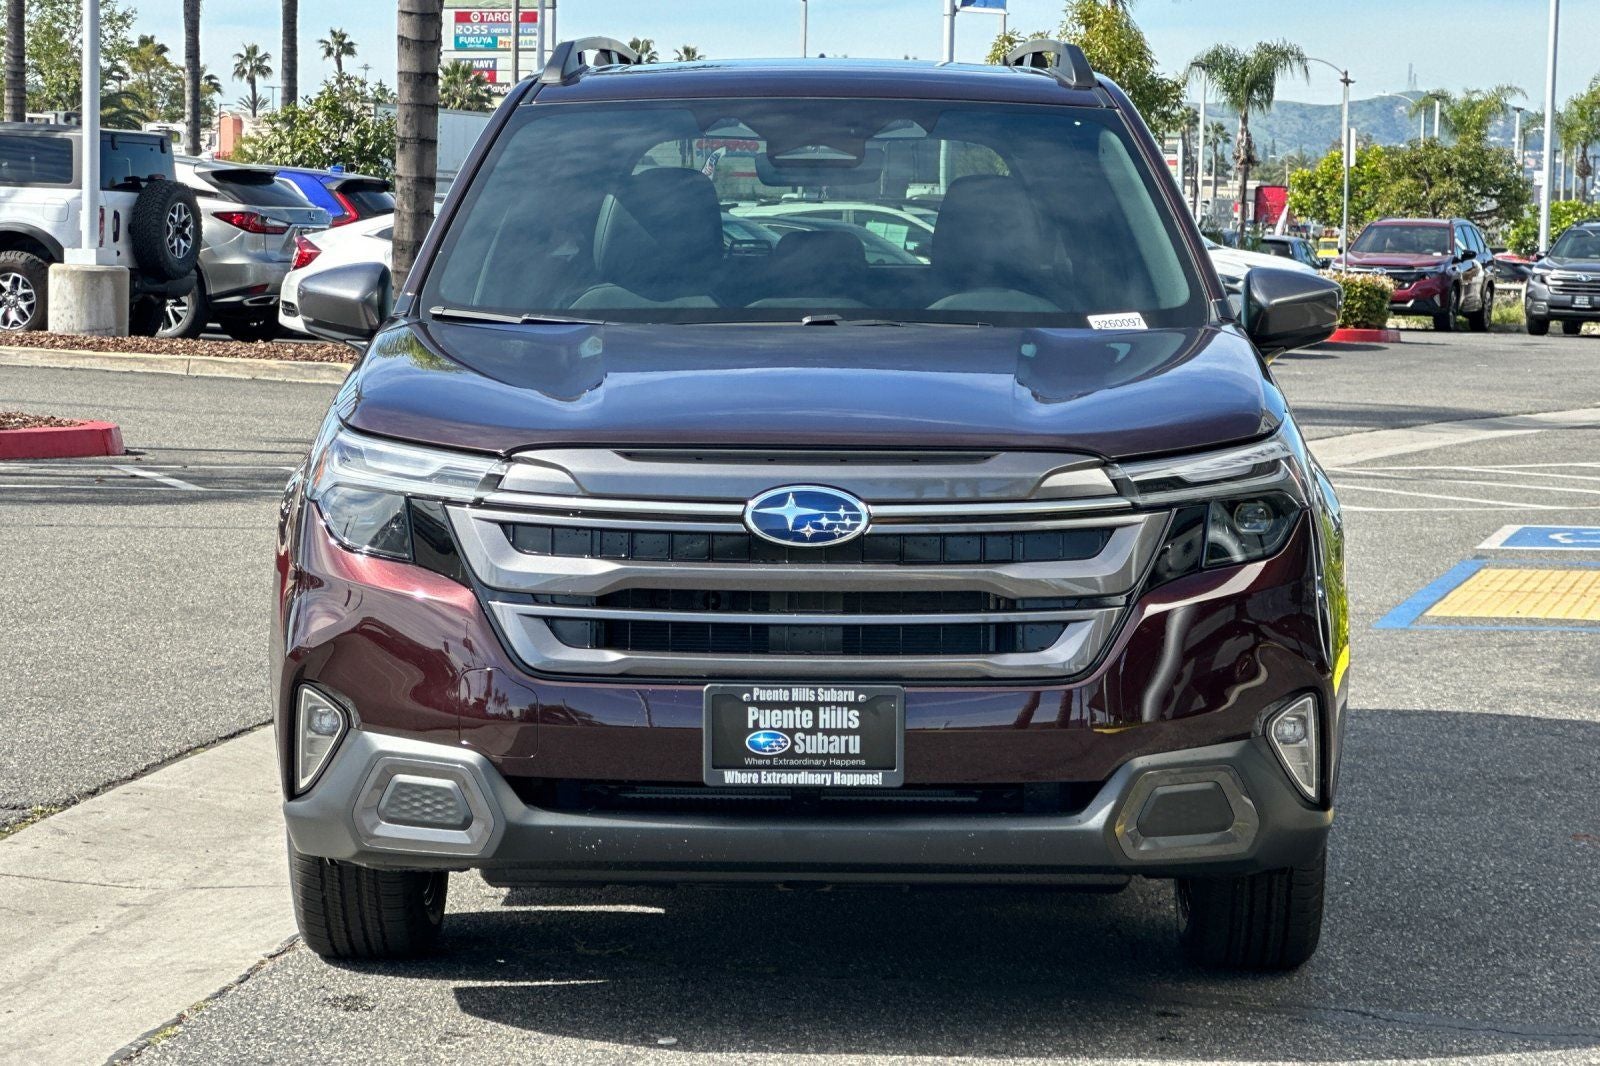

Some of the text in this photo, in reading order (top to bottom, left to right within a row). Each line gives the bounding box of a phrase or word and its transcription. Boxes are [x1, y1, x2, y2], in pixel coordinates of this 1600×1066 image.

[455, 25, 488, 34] ROSS
[459, 36, 493, 44] FUKUYA
[473, 60, 494, 69] NAVY
[1094, 317, 1142, 329] 3260097
[753, 687, 855, 702] Puente Hills Subaru
[747, 705, 860, 729] Puente Hills
[794, 732, 861, 754] Subaru
[744, 757, 866, 767] Where Extraordinary Happens
[723, 770, 883, 786] Where Extraordinary Happens!
